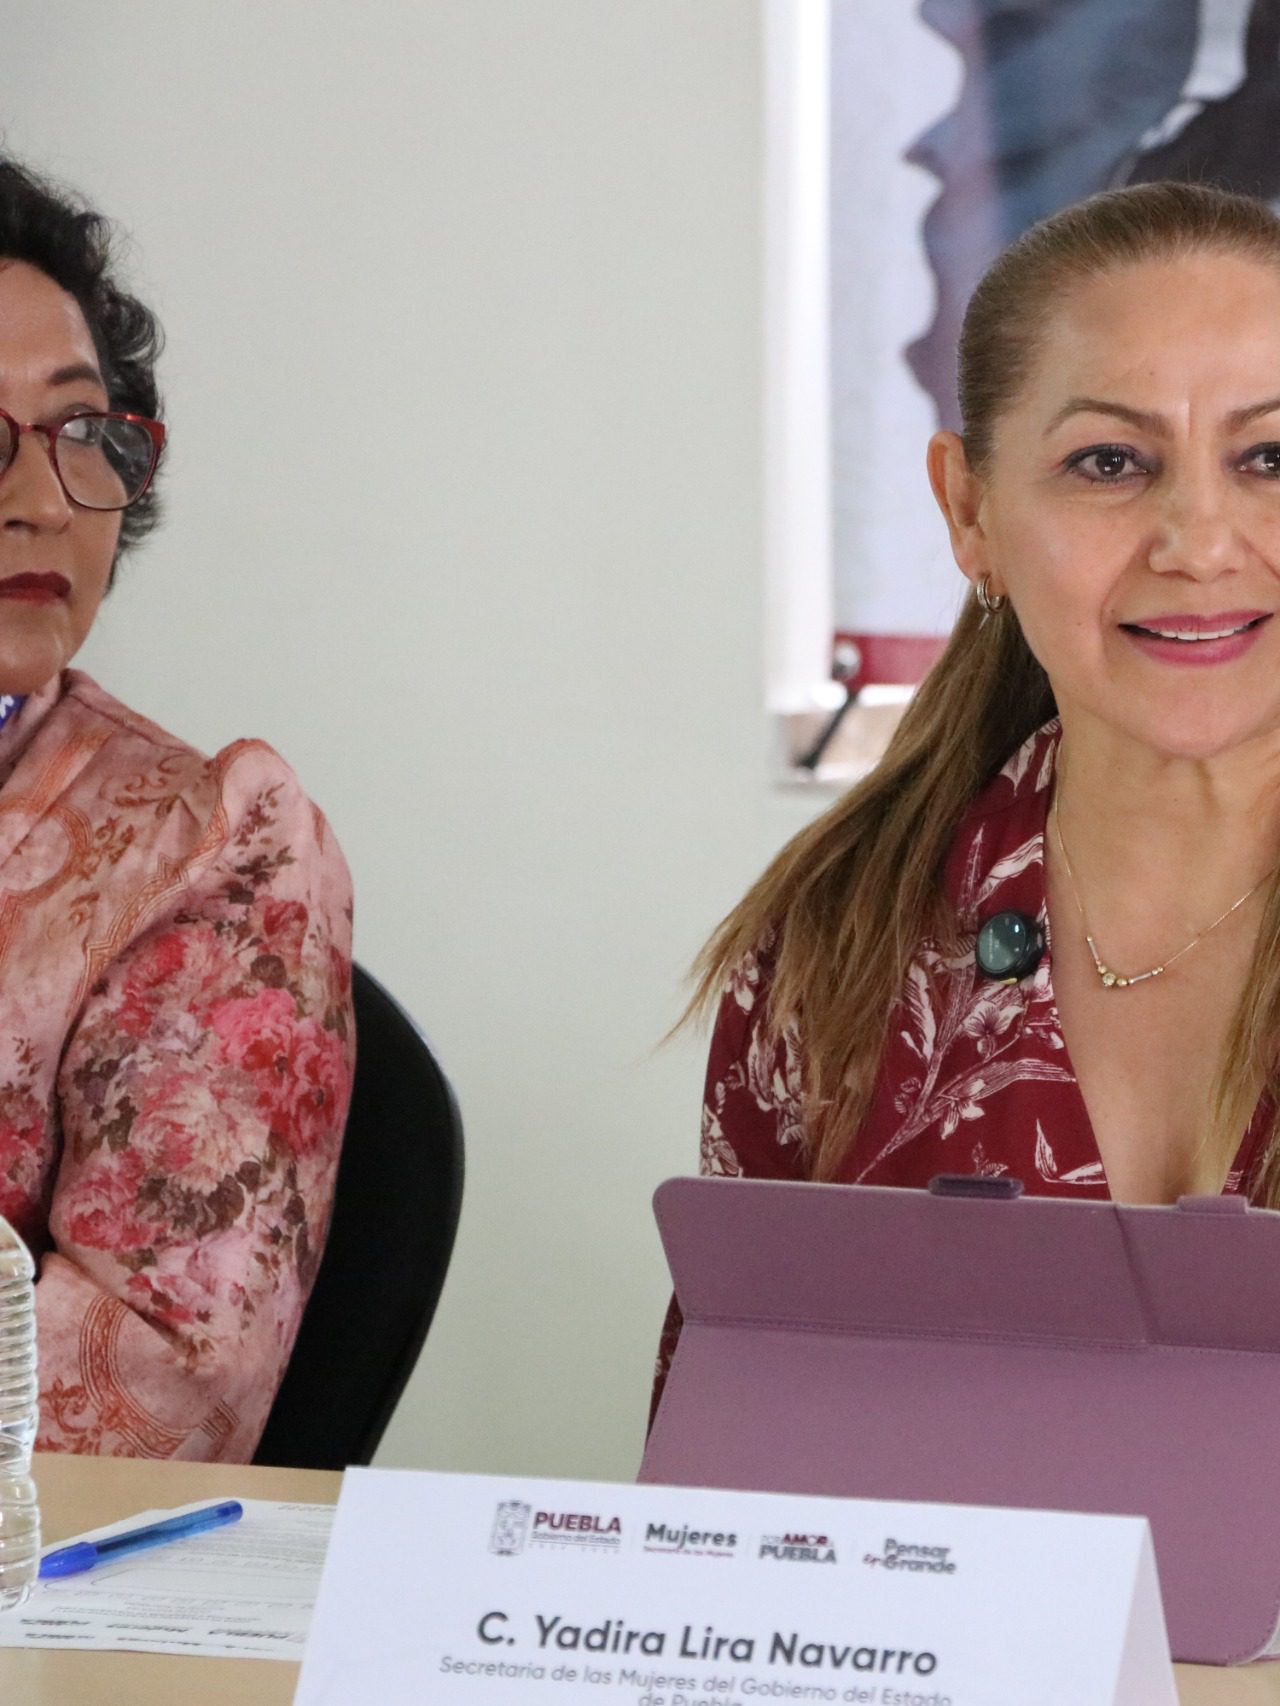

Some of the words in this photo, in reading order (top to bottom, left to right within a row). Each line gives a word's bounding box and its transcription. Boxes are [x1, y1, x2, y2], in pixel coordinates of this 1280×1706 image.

[533, 1511, 622, 1535] PUEBLA
[645, 1522, 738, 1549] Mujeres
[759, 1544, 836, 1563] PUEBLA
[884, 1537, 950, 1558] Pensar
[885, 1554, 956, 1574] Grande
[477, 1611, 515, 1646] C.
[535, 1615, 666, 1656] Yadira
[679, 1625, 755, 1662] Lira
[768, 1632, 938, 1676] Navarro
[551, 1665, 578, 1682] de
[584, 1666, 612, 1684] las
[619, 1669, 696, 1692] Mujeres
[703, 1675, 735, 1693] del
[740, 1678, 837, 1701] Gobierno
[843, 1685, 876, 1703] del
[882, 1688, 952, 1706] Estado
[672, 1694, 743, 1706] Puebl
